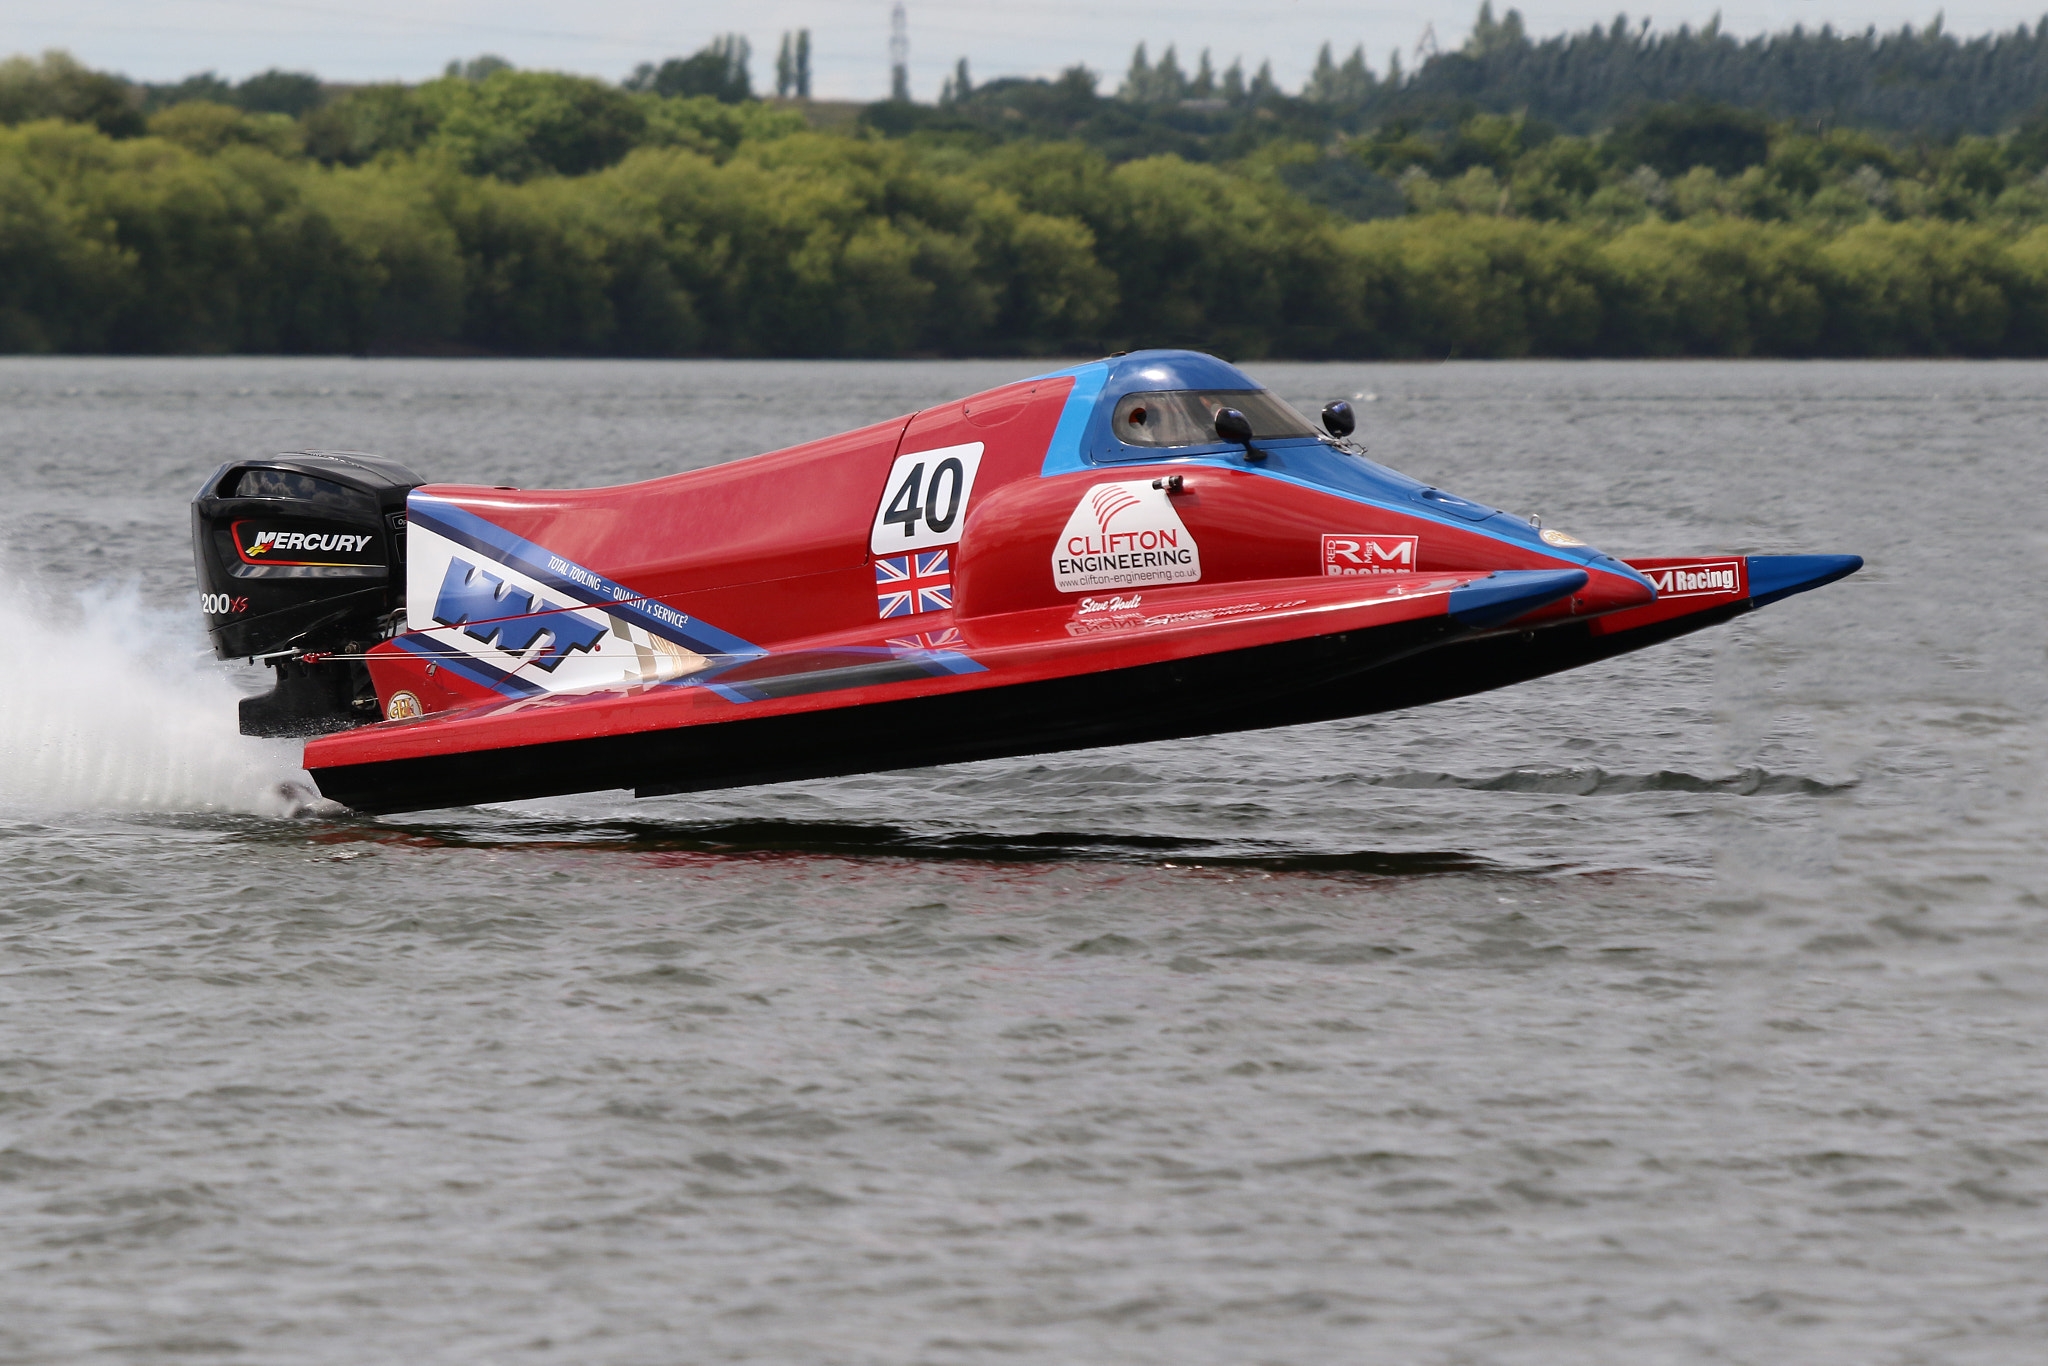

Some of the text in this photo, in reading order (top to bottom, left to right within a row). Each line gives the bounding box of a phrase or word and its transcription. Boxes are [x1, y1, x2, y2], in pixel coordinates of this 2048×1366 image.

[883, 457, 964, 538] 40
[254, 531, 372, 551] MERCURY
[1068, 529, 1178, 556] CLIFTON
[1327, 540, 1336, 563] RED
[1058, 550, 1192, 575] ENGINEERING
[547, 555, 570, 576] TOTAL
[568, 565, 602, 591] TOOLING
[613, 586, 648, 611] QUALITY
[1058, 568, 1198, 588] www.clifton-engineering.co.uk
[1675, 568, 1734, 591] Racing
[202, 593, 230, 614] 200
[1078, 598, 1109, 615] Steve
